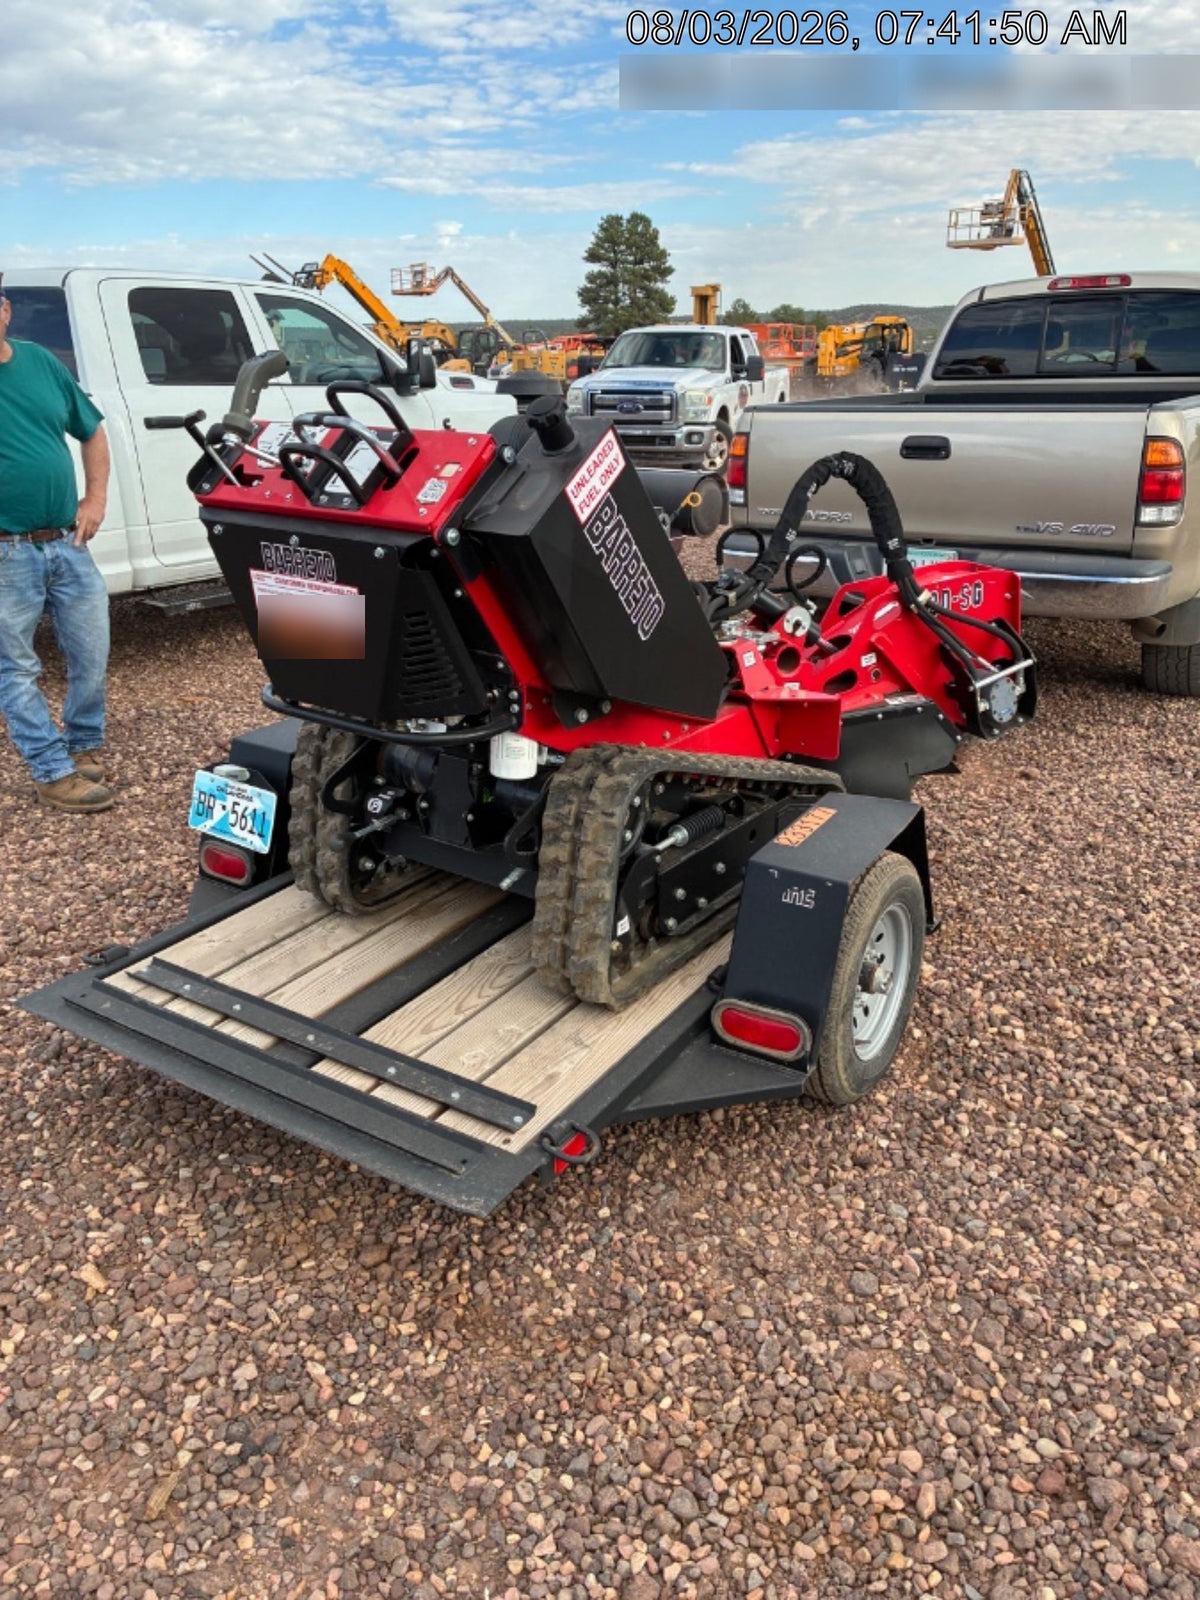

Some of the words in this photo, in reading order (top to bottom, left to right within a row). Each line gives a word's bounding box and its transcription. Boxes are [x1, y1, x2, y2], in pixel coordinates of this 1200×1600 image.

[570, 440, 614, 499] UNLEADED
[579, 485, 601, 514] FUEL
[600, 453, 620, 486] ONLY
[582, 491, 666, 641] BARRETO
[229, 801, 266, 839] 5611
